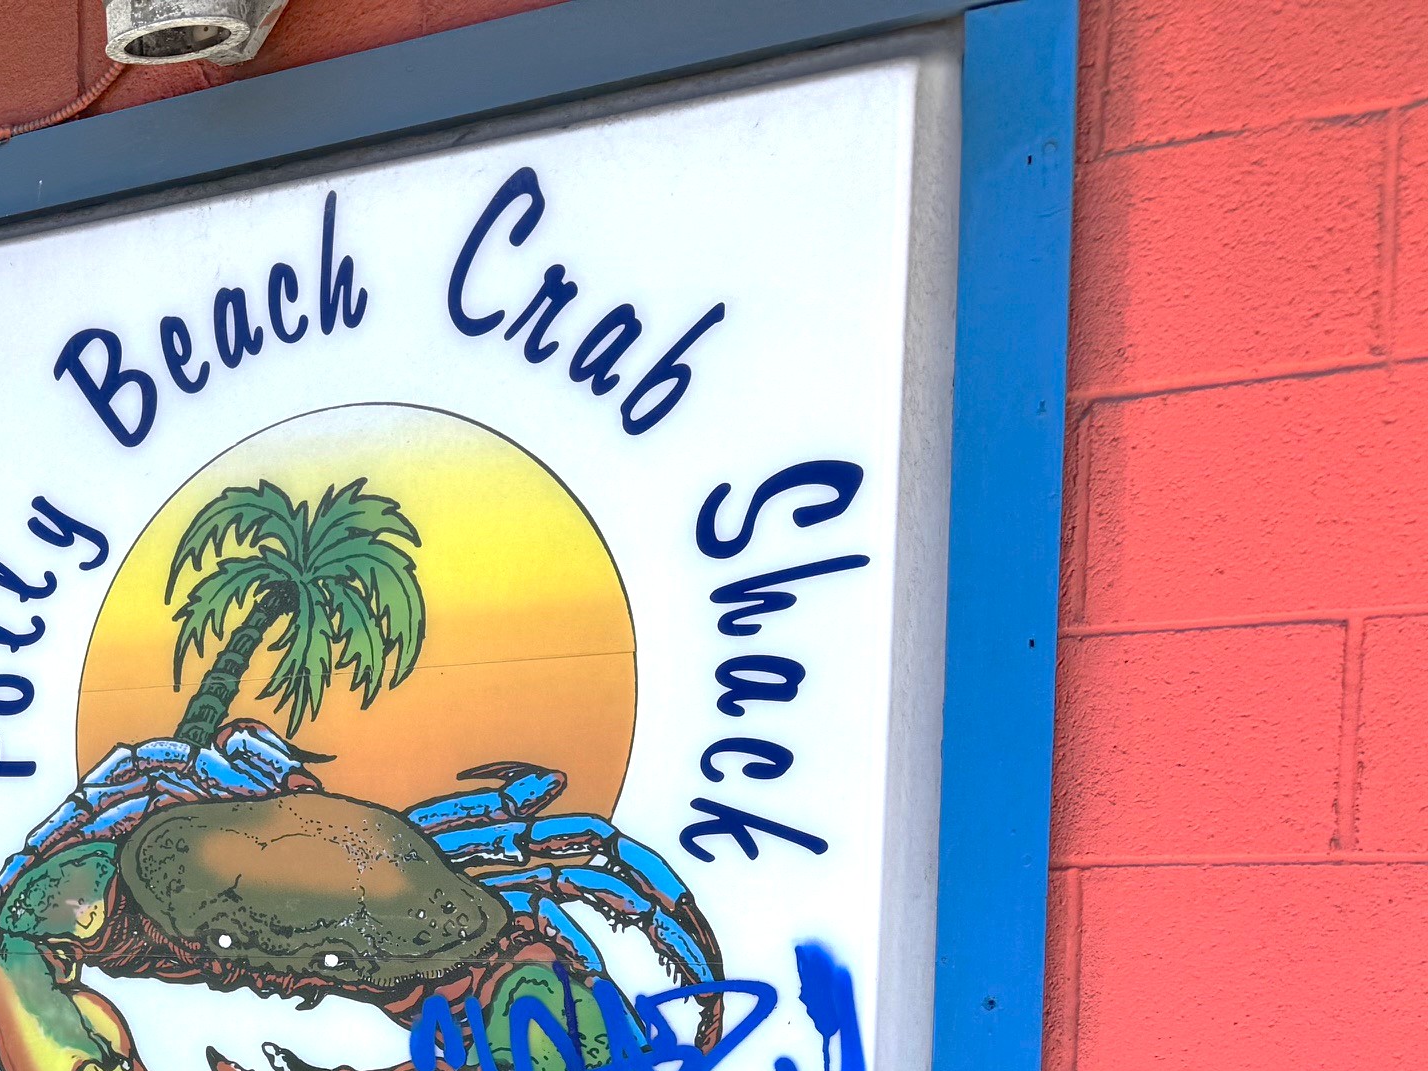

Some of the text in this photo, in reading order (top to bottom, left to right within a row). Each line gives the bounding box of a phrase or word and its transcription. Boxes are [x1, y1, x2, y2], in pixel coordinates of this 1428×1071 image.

[53, 191, 368, 448] Beach
[447, 167, 725, 436] Crab
[679, 459, 871, 863] Shack
